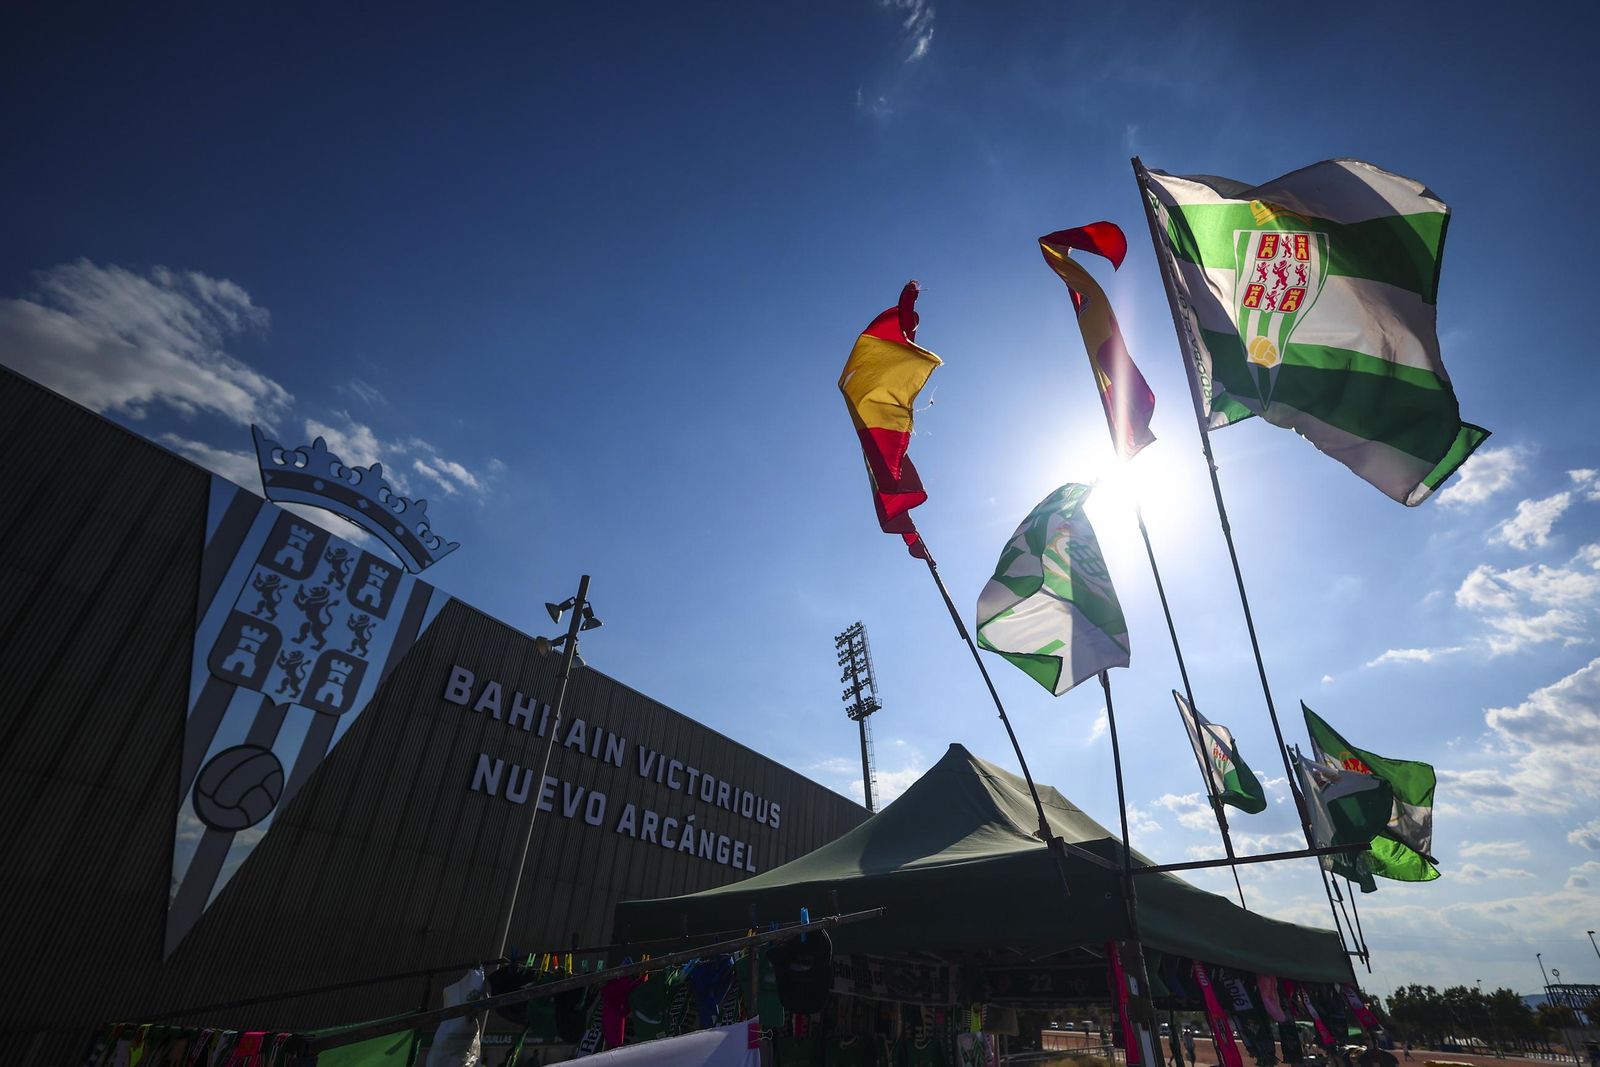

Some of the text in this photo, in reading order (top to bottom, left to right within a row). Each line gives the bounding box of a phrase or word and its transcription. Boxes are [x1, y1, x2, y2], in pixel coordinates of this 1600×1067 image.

[443, 665, 781, 829] BAHRAIN VICTORIOUS
[470, 754, 756, 874] NUEVO ARCÁNGEL
